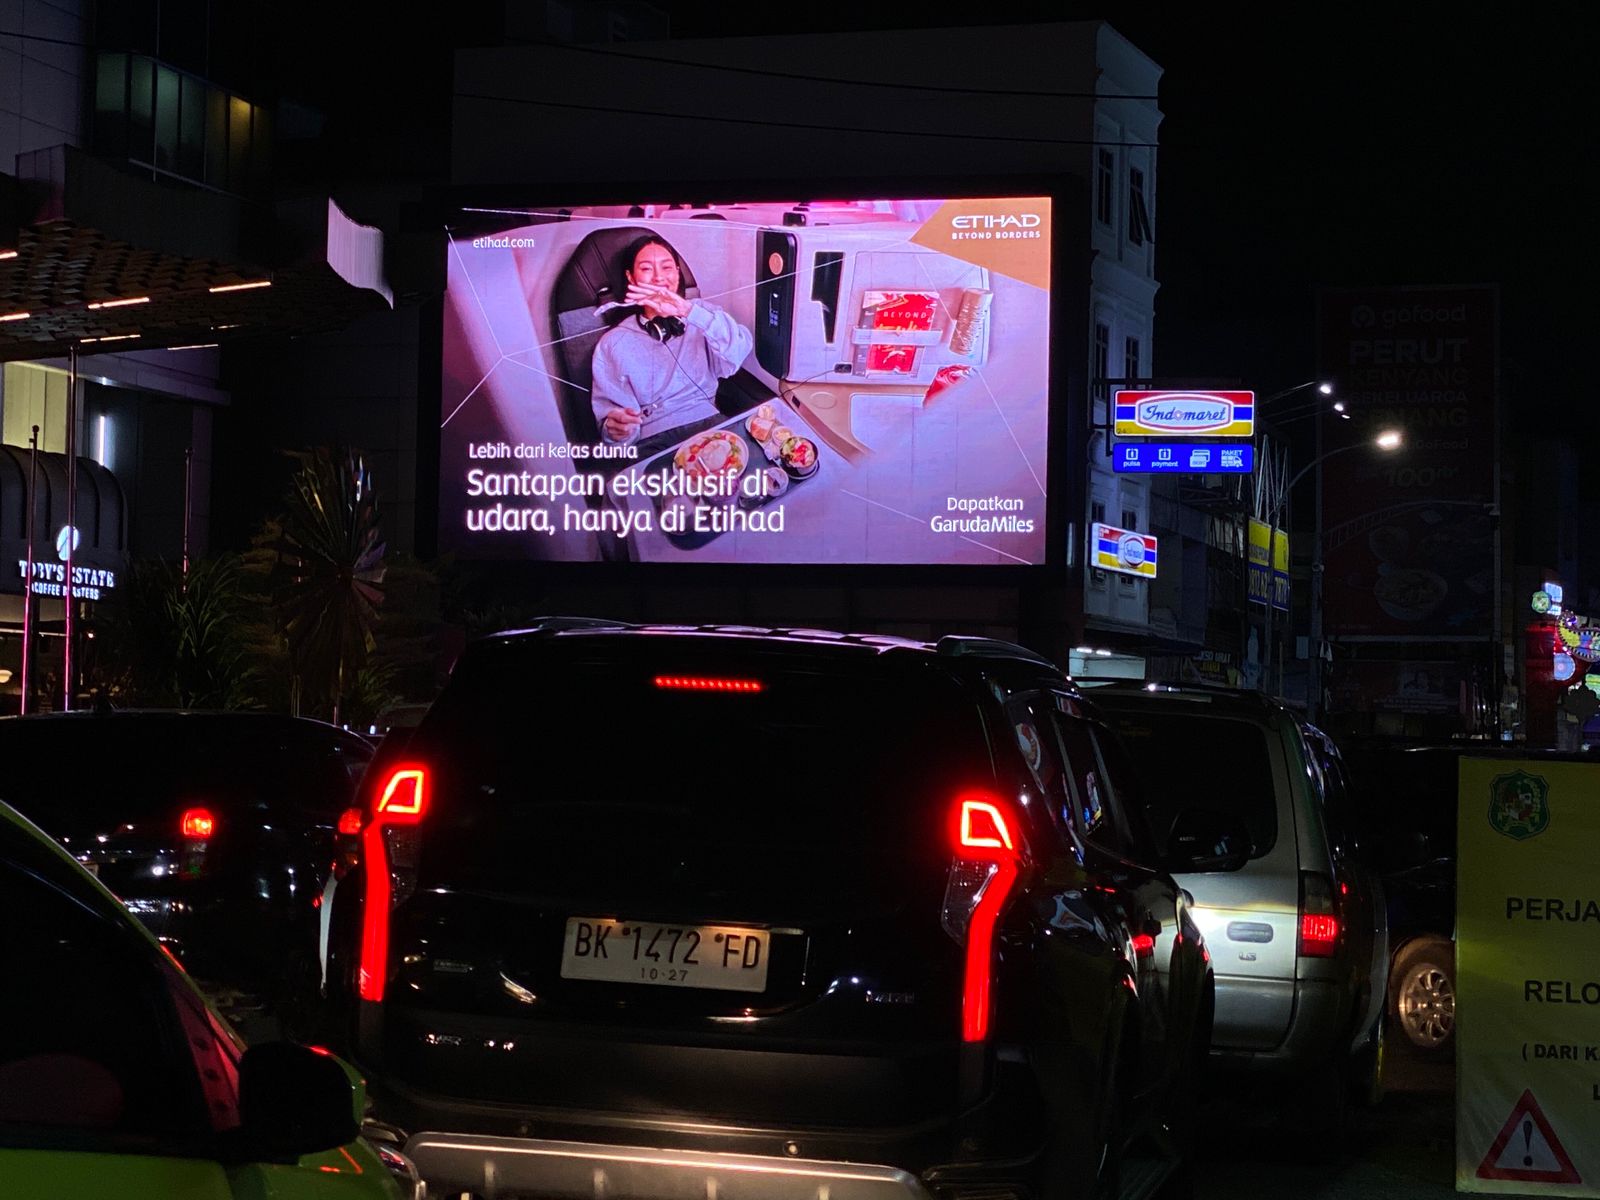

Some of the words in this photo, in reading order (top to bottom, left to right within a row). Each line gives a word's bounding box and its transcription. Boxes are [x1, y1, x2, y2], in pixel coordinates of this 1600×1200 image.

[951, 213, 1041, 229] ETIHAD
[472, 236, 535, 249] etihad.com
[951, 231, 992, 241] BEYOND
[995, 230, 1041, 240] BORDERS
[883, 311, 927, 319] BEYOND
[1348, 337, 1469, 364] PERUT
[1349, 367, 1469, 386] KENYANG
[1142, 404, 1226, 422] Indomaret
[468, 442, 511, 460] Lebih
[514, 442, 544, 460] dari
[548, 442, 590, 460] kelas
[592, 443, 639, 460] dunia
[1123, 460, 1141, 469] pulsa
[1151, 460, 1179, 469] payment
[466, 468, 605, 502] Santapan
[612, 467, 737, 497] eksklusif
[743, 467, 769, 498] di
[946, 495, 1024, 514] Dapatkan
[466, 503, 556, 536] udara,
[563, 503, 653, 538] hanya
[660, 504, 686, 533] di
[694, 503, 785, 533] Etihad
[930, 515, 1035, 533] GarudaMiles
[62, 585, 100, 601] RASTERS
[575, 922, 613, 959] BK
[632, 926, 702, 966] 1472
[722, 934, 761, 970] FD
[1534, 1043, 1578, 1061] DARI
